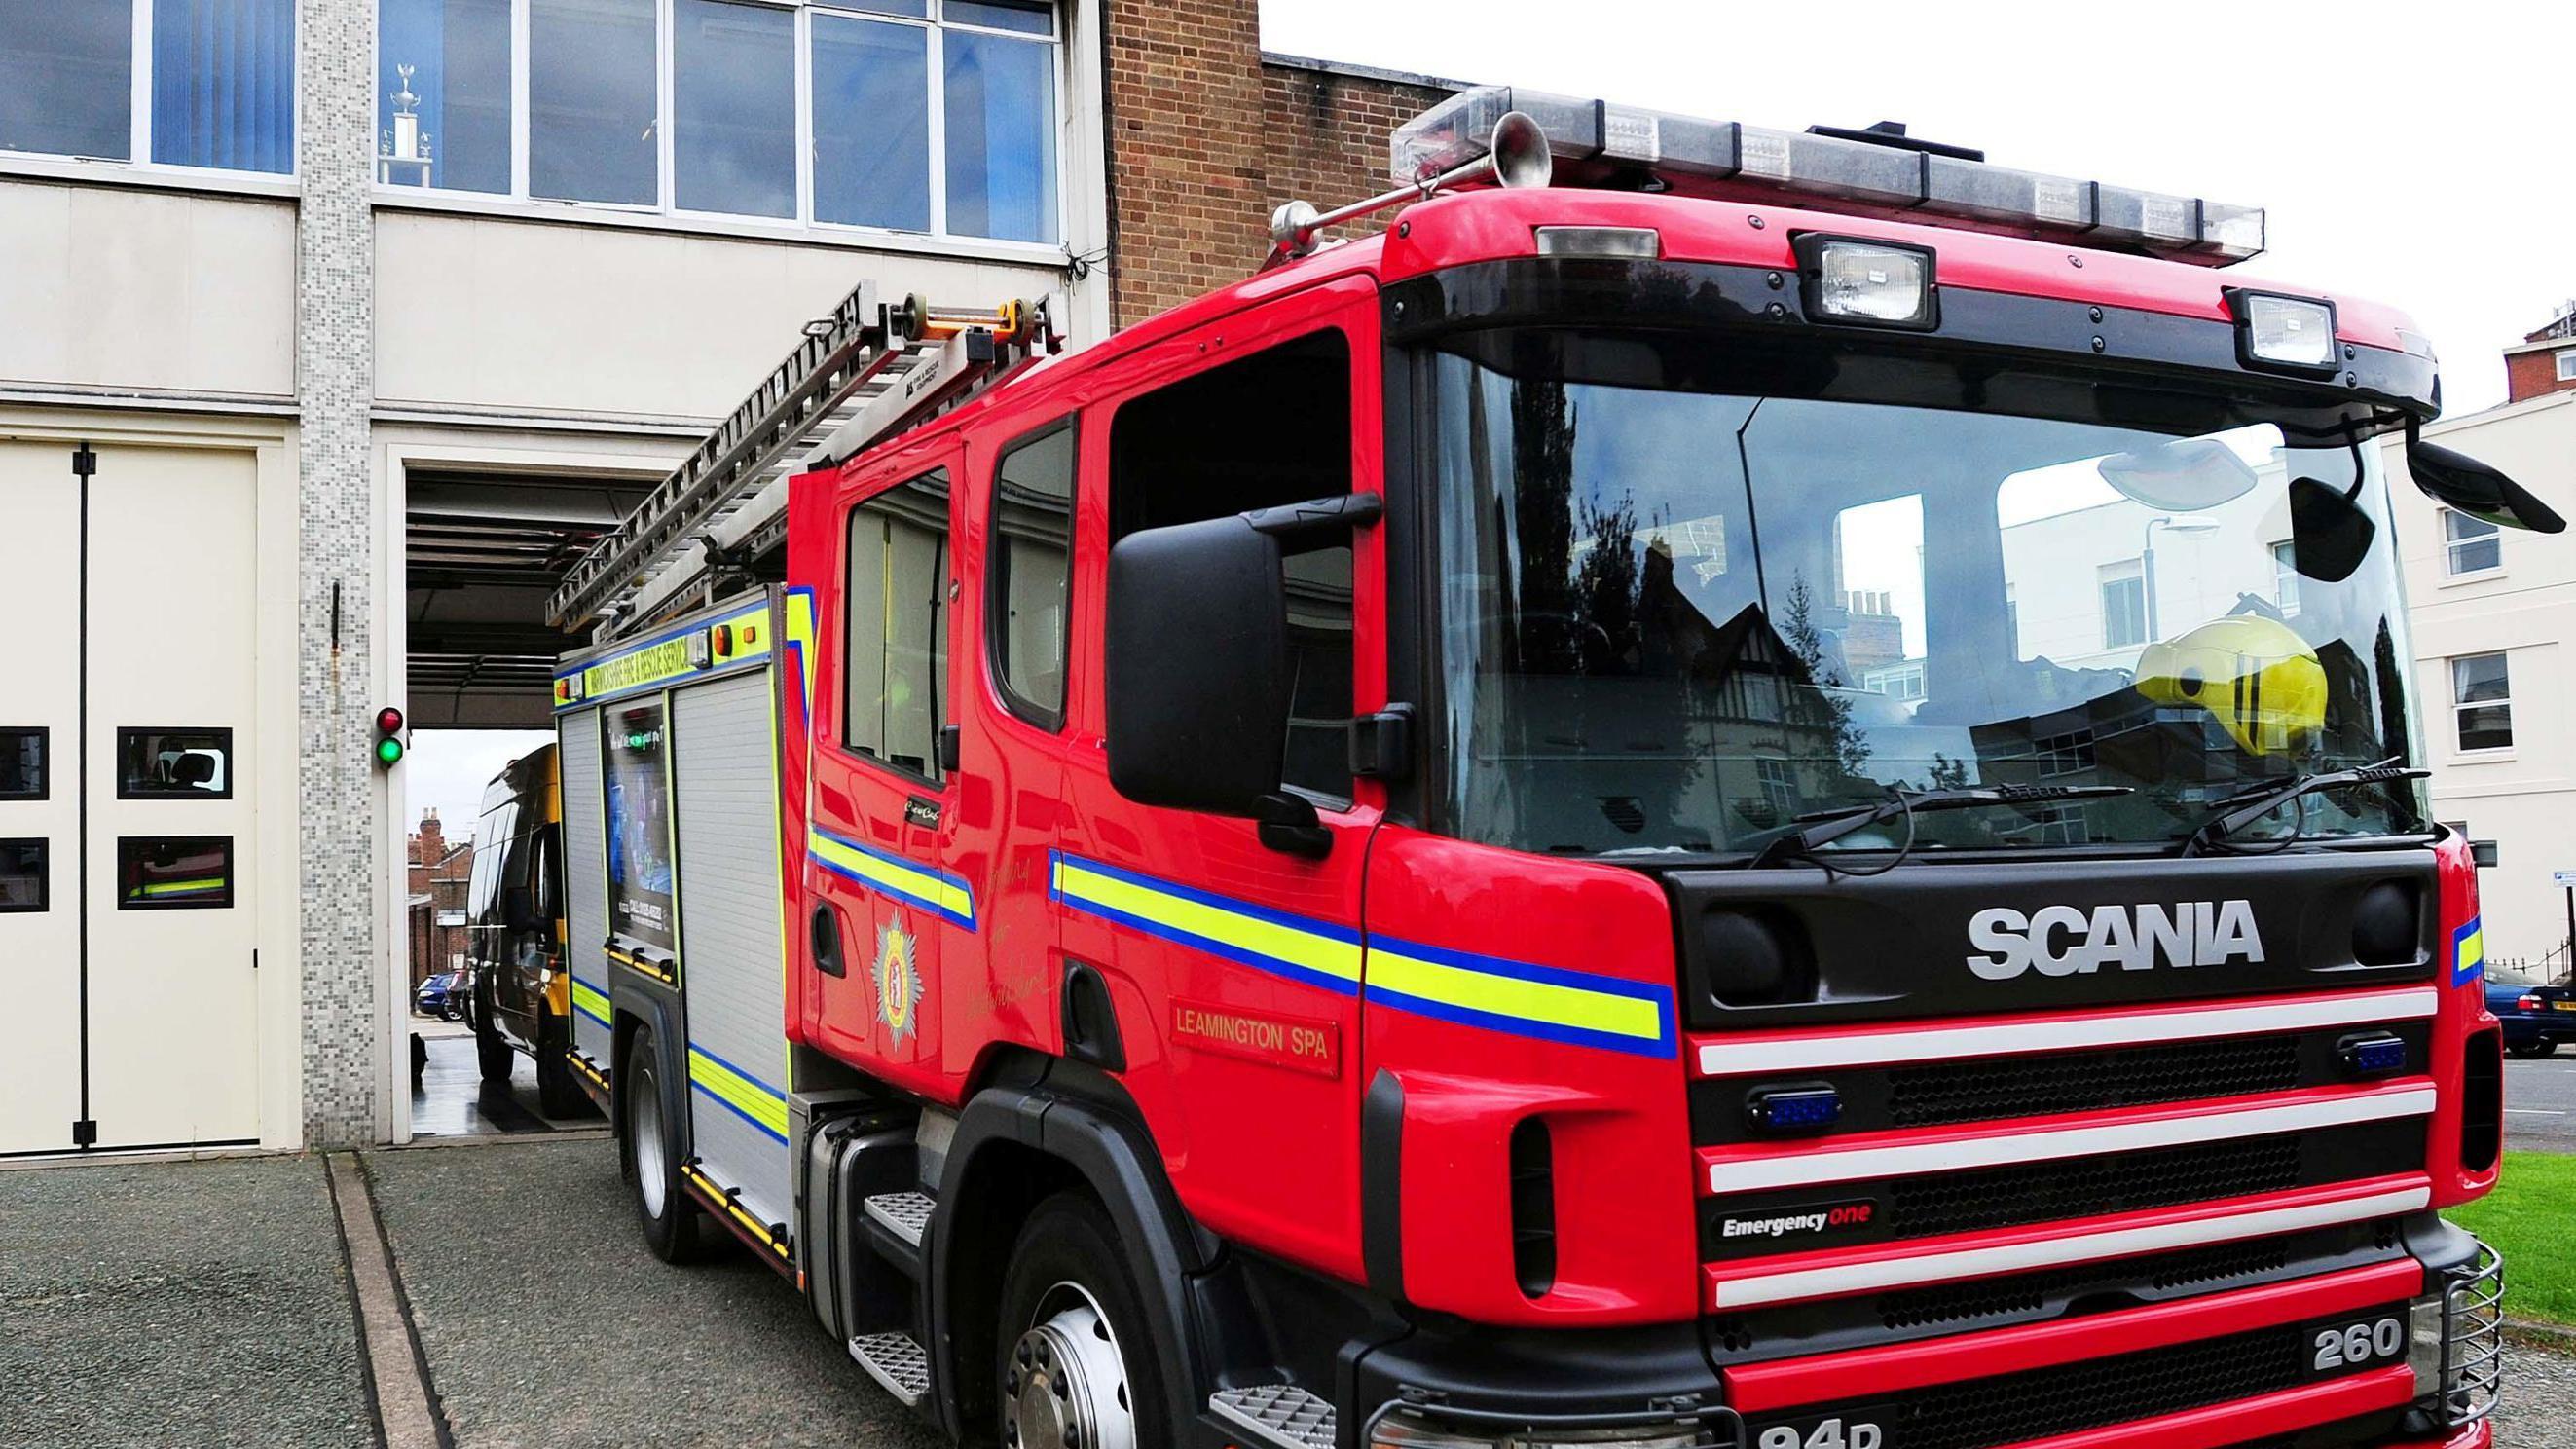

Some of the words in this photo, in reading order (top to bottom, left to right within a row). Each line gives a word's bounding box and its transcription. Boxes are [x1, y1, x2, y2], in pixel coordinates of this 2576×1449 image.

[1967, 899, 2265, 980] SCANIA
[1176, 1007, 1283, 1051] LEAMINGTON
[1291, 1026, 1328, 1059] SPA
[1722, 1212, 1828, 1237] Emergency
[1828, 1205, 1872, 1225] one
[2314, 1318, 2402, 1371] 260
